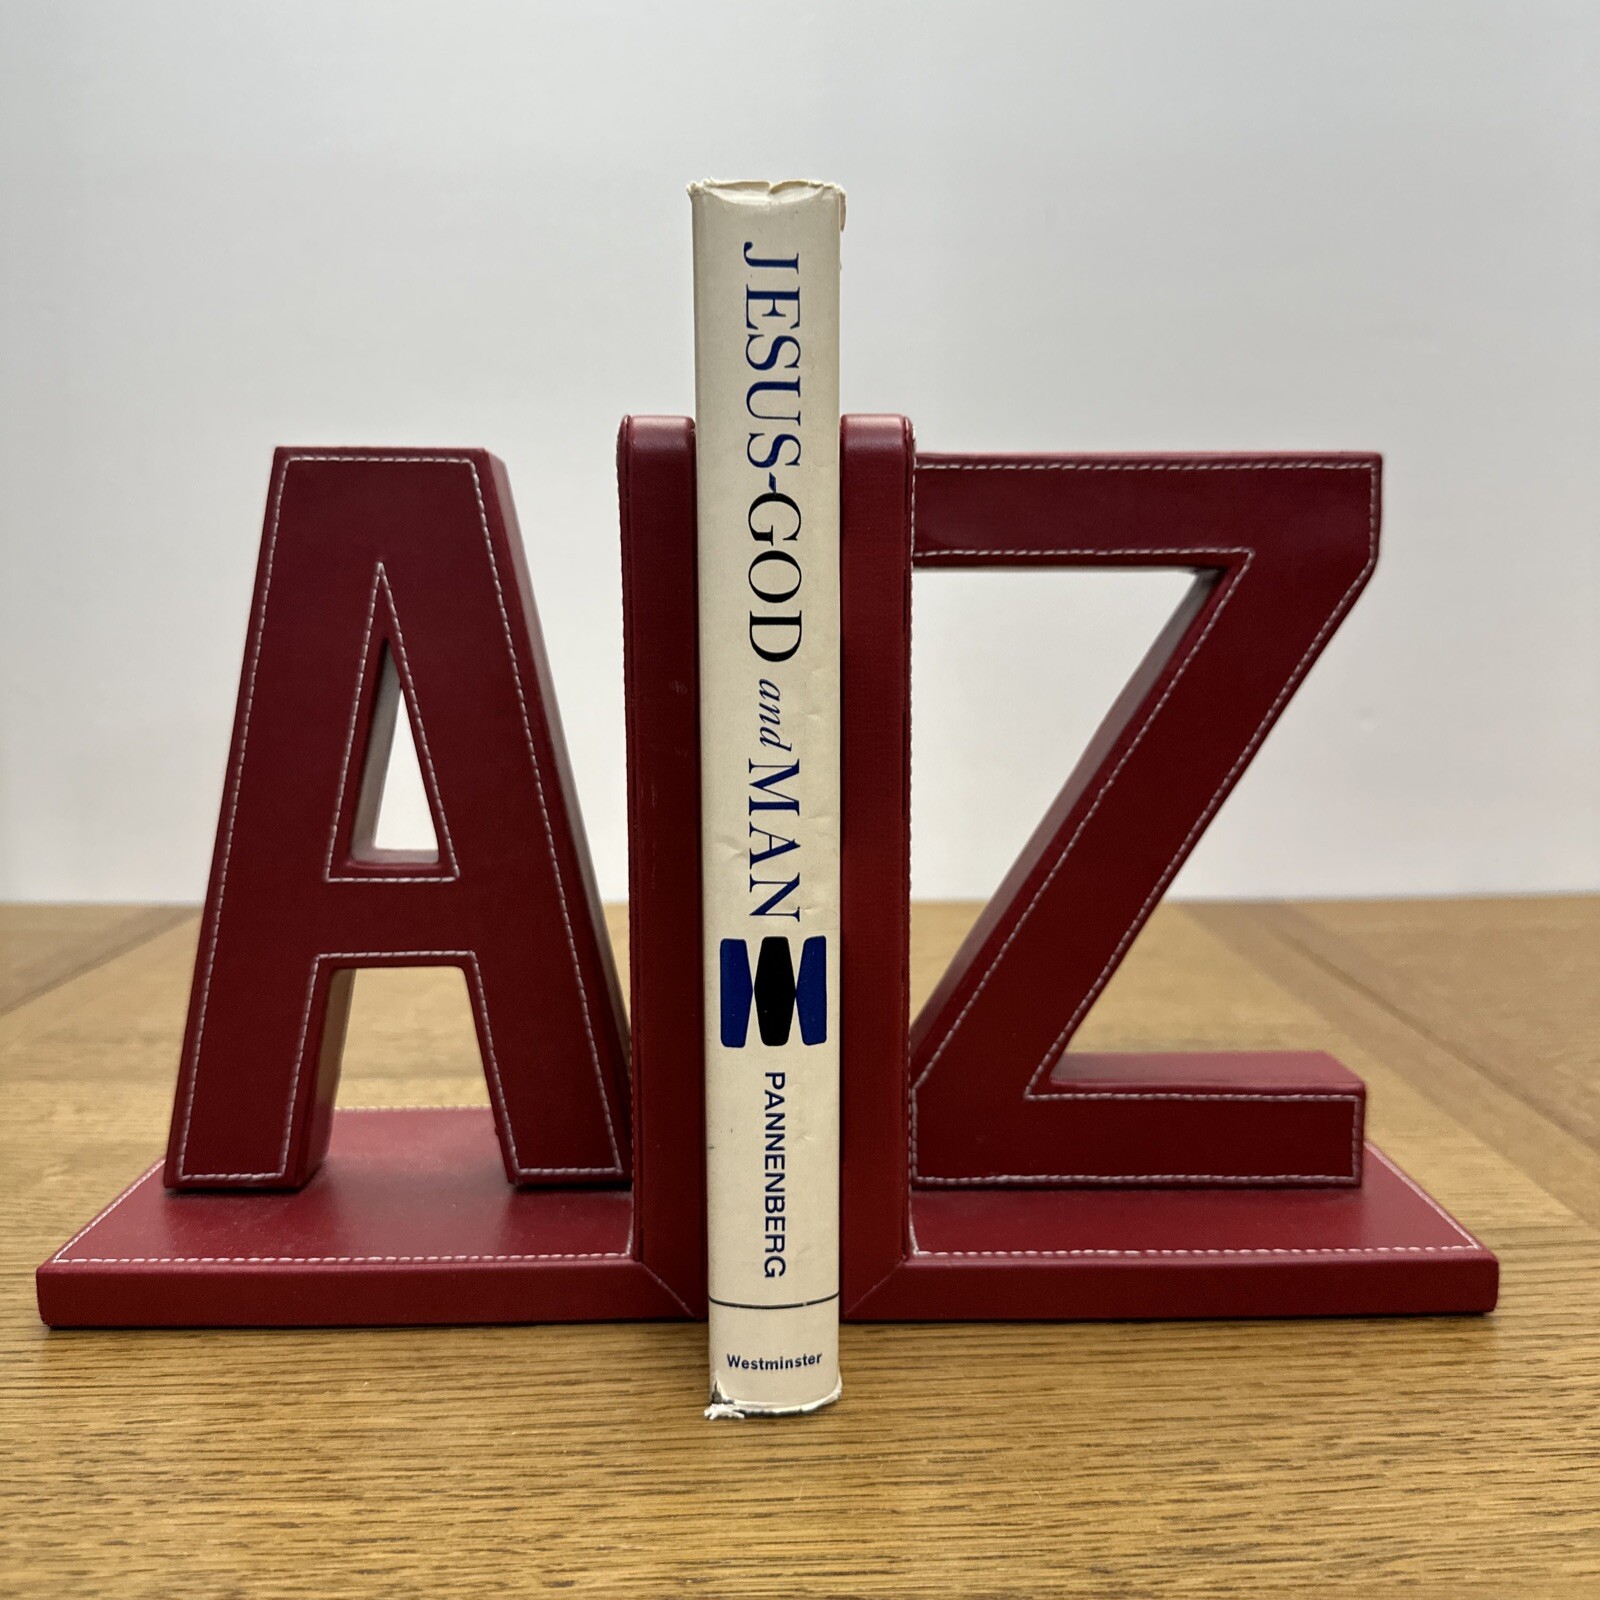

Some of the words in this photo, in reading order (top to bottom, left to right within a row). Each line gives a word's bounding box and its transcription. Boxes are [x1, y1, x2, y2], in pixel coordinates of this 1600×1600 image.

[743, 241, 802, 662] JESUS-GOD
[164, 446, 632, 1190] A
[758, 678, 793, 752] and
[748, 758, 801, 922] MAN
[911, 451, 1383, 1189] Z
[764, 1071, 787, 1279] PANNENBERG
[726, 1352, 823, 1371] Westminster
